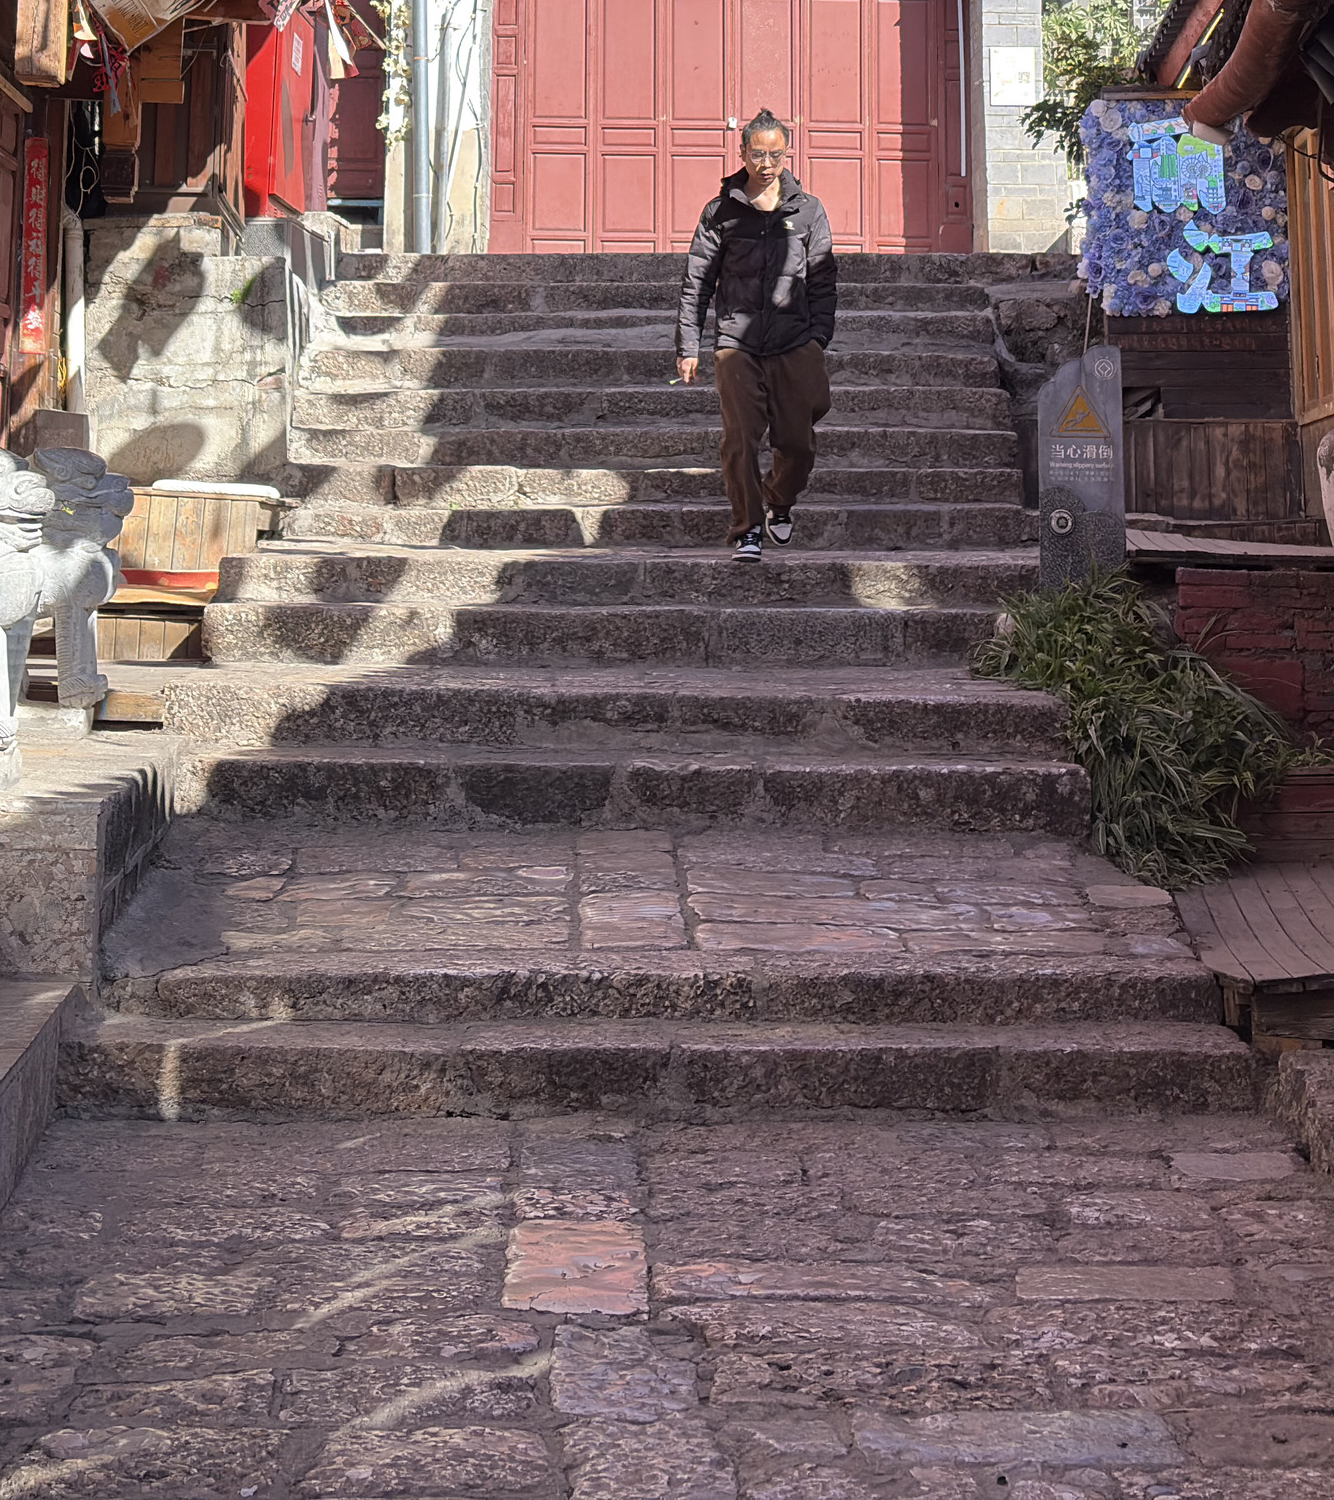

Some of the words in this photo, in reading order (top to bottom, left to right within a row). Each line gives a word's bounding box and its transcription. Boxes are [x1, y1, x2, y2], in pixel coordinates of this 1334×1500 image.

[1127, 116, 1279, 314] 丽江
[1051, 444, 1113, 459] 当心滑倒
